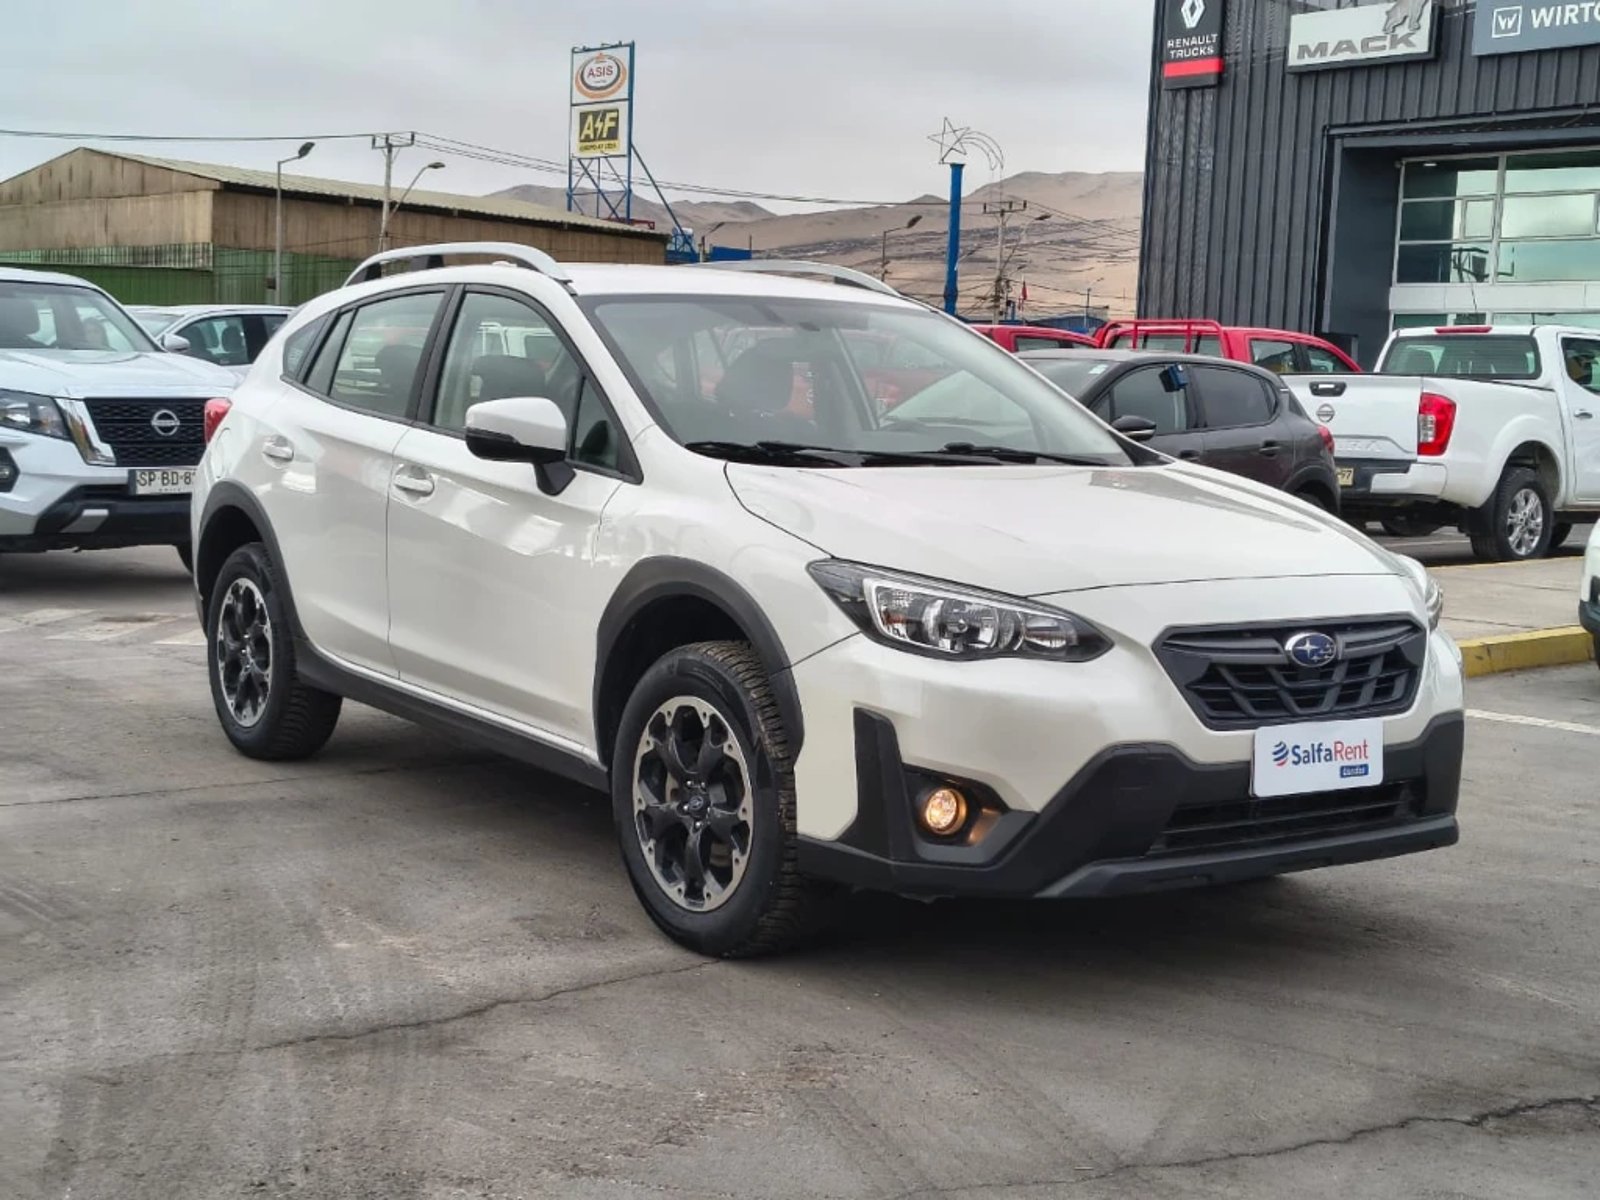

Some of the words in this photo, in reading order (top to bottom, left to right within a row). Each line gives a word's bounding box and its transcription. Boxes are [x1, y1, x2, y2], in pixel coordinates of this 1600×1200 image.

[1167, 33, 1218, 48] RENAULT
[1296, 32, 1417, 60] MACK
[1170, 45, 1214, 58] TRUCKS
[587, 65, 614, 79] ASIS
[1291, 739, 1369, 766] SalfaRent
